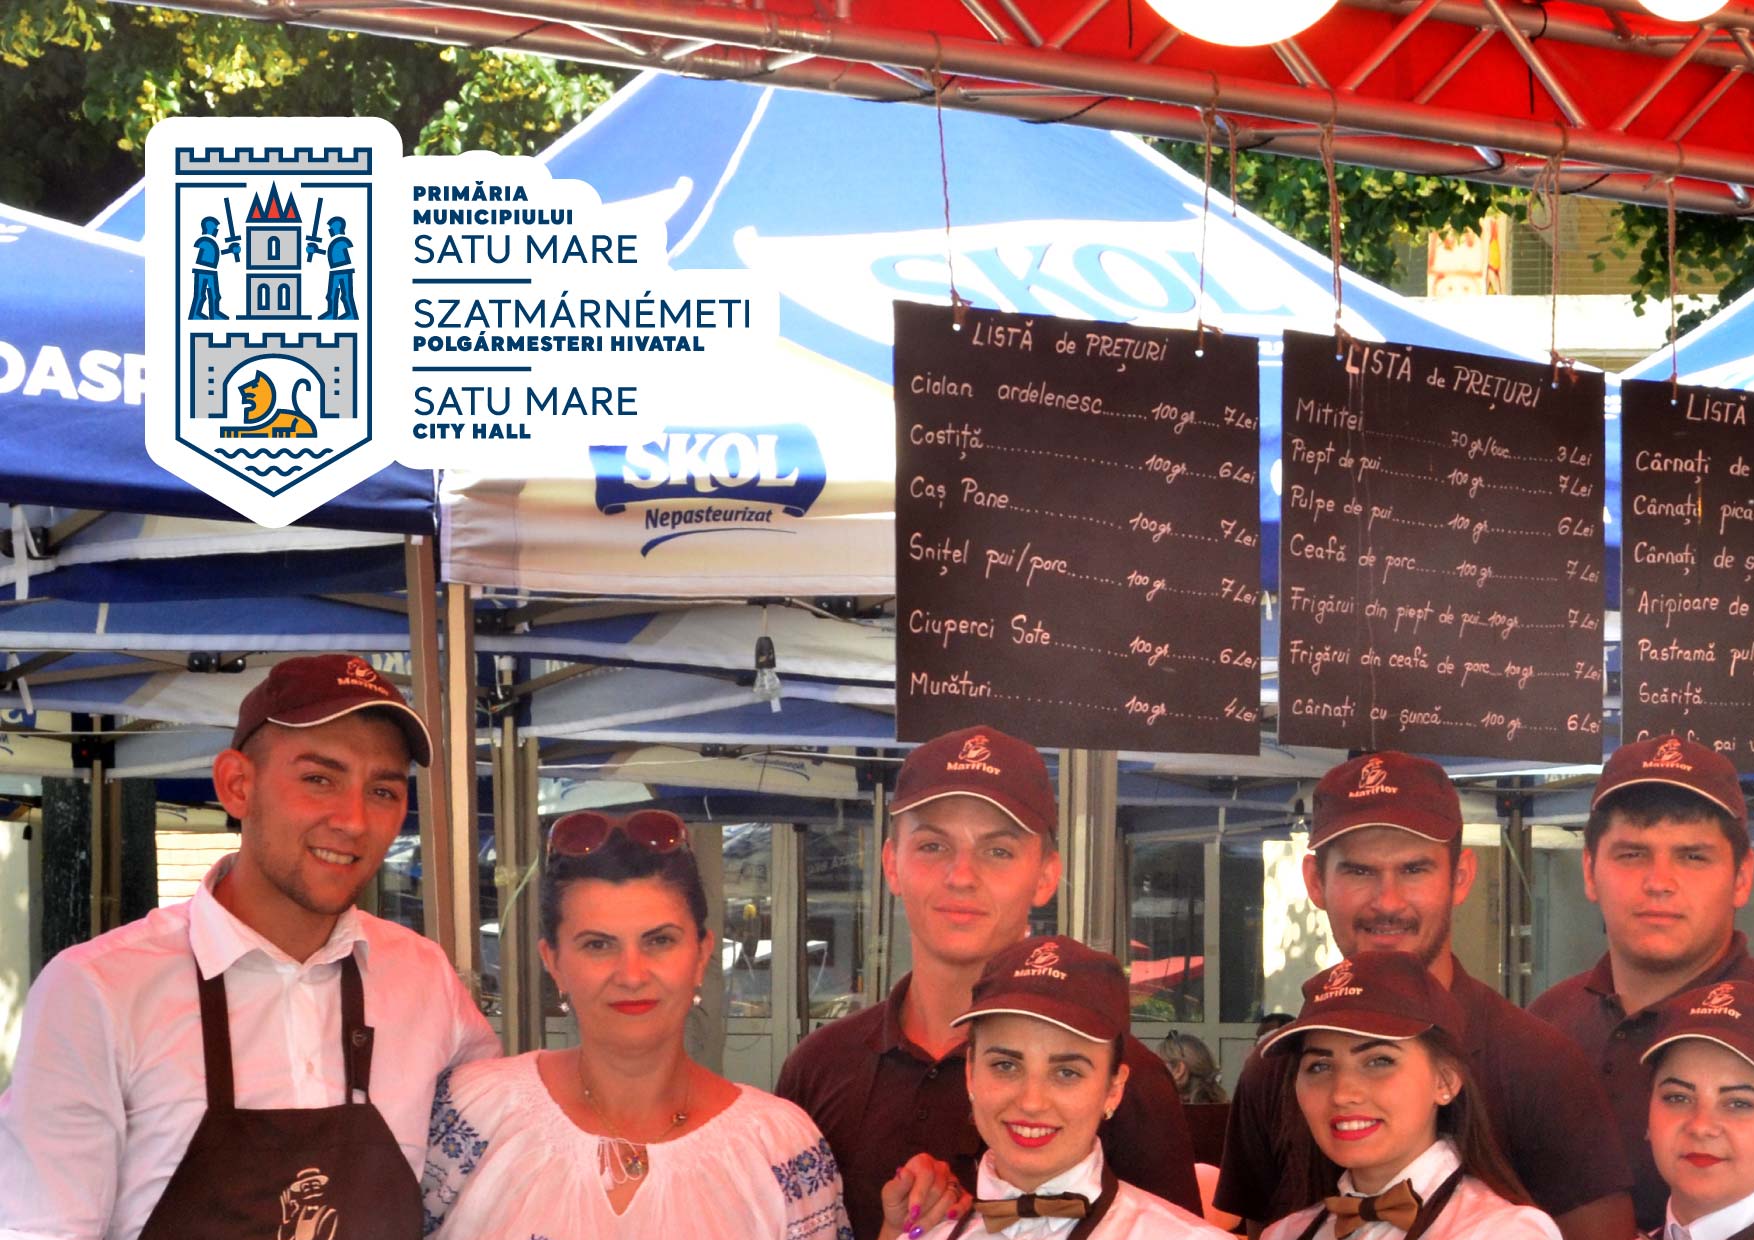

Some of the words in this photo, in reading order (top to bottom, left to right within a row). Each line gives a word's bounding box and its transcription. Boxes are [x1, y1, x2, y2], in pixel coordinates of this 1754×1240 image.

[1056, 332, 1076, 354] de
[1427, 368, 1446, 388] de
[911, 371, 974, 398] Ciolan
[998, 381, 1103, 414] ardelenesc
[1296, 397, 1364, 431] Mititei
[1569, 446, 1593, 466] Lei
[622, 432, 800, 493] SKOL
[1291, 438, 1335, 476] Piept
[1338, 449, 1355, 468] de
[1360, 456, 1382, 484] pui
[1570, 477, 1593, 497] Lei
[1729, 456, 1750, 477] de
[961, 477, 1009, 508] Pane
[645, 506, 773, 531] Nepasteurizat
[1291, 484, 1335, 523] Pulpe
[1344, 497, 1363, 516] de
[1367, 505, 1393, 531] pui
[1573, 519, 1595, 537] Lei
[1358, 546, 1376, 567] de
[1384, 555, 1416, 585] porc
[1713, 547, 1735, 568] de
[1439, 604, 1455, 625] de
[1637, 590, 1719, 628] Aripioare
[1729, 595, 1749, 616] de
[909, 609, 994, 649] Ciuperci
[1011, 614, 1051, 645] Sote
[1437, 656, 1455, 674] de
[946, 761, 1001, 776] Mariflor
[1348, 784, 1399, 800] Mariflor
[1014, 965, 1067, 981] Mariflor
[1314, 986, 1364, 1003] Mariflor
[1689, 1005, 1742, 1020] Mariflor
